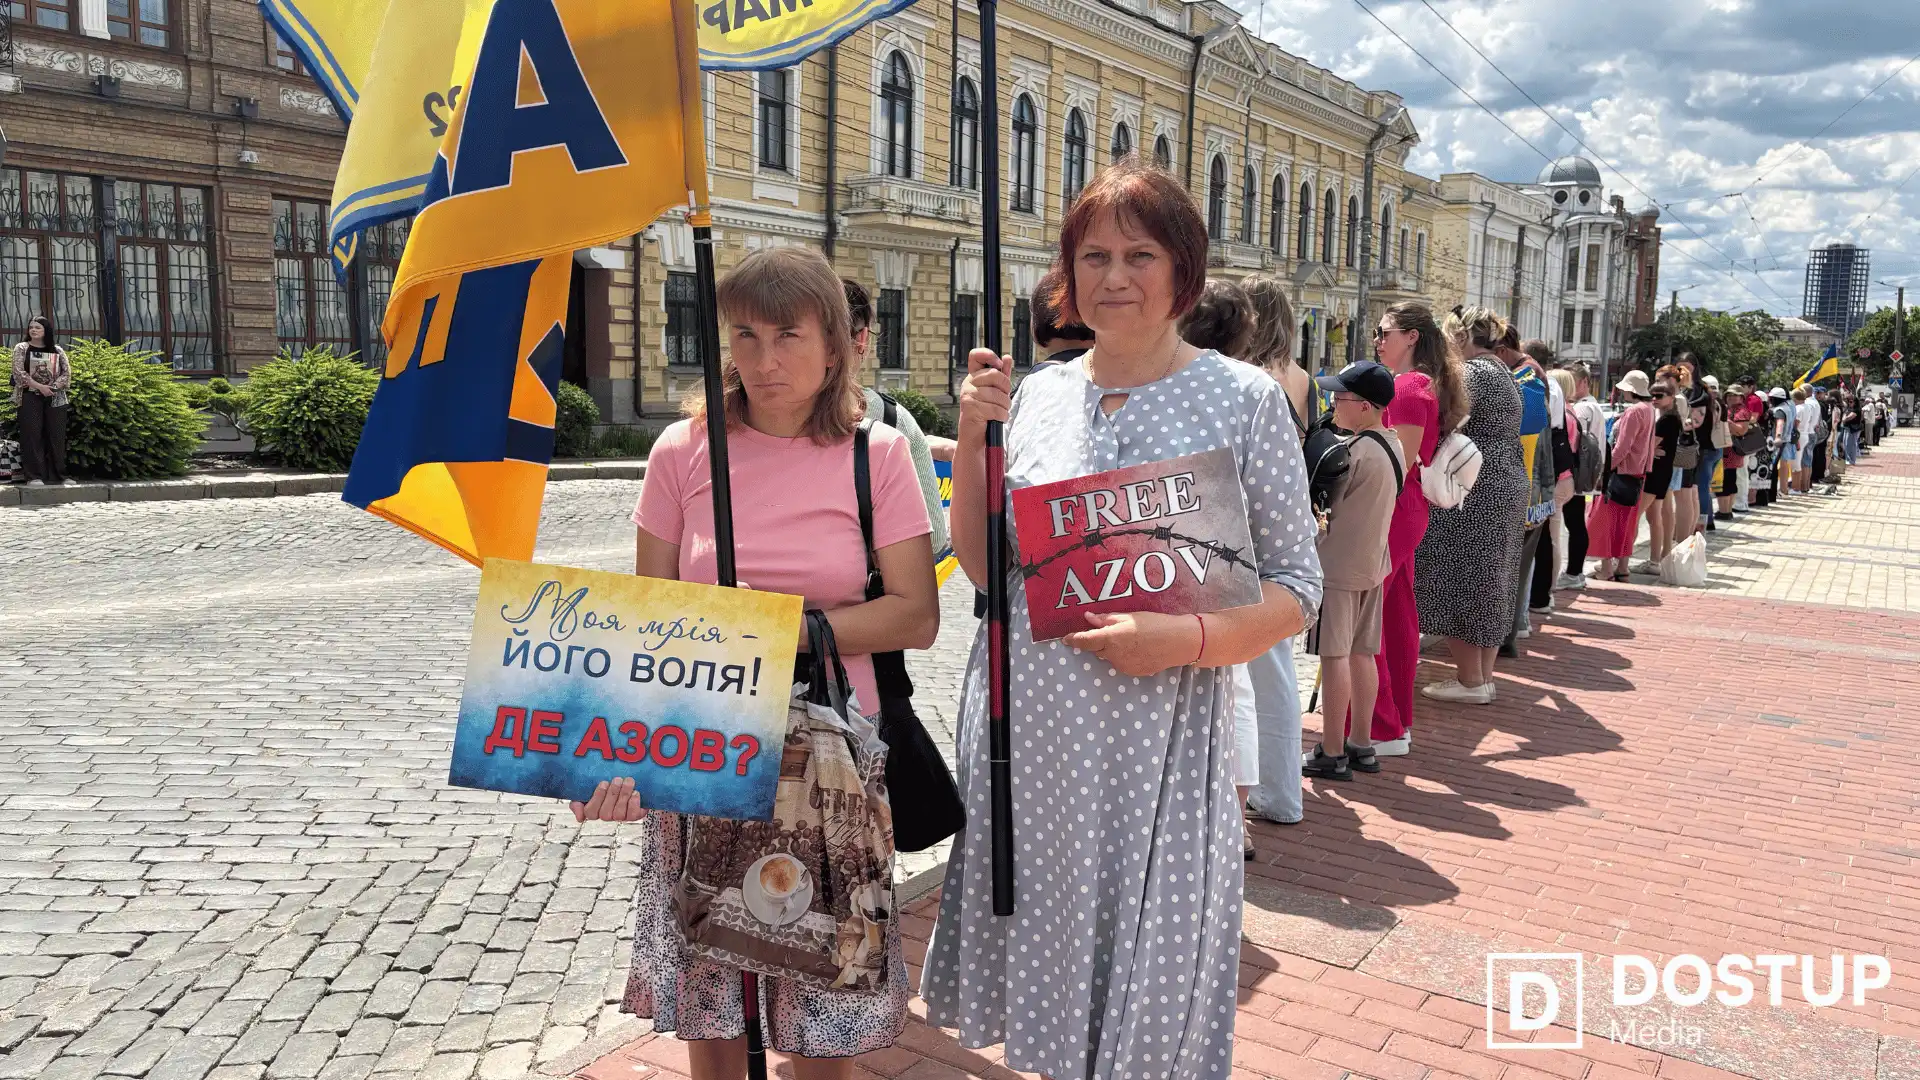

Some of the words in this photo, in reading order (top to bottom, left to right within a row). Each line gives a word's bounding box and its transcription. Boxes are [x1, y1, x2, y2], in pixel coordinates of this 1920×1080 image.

[1045, 472, 1201, 539] FREE
[1055, 541, 1218, 609] AZOV
[501, 580, 627, 642] Моя
[638, 616, 728, 651] мрія
[502, 628, 611, 678] ЙОГО
[630, 653, 762, 696] ВОЛЯ!
[484, 706, 565, 758] ДЕ
[574, 717, 760, 776] АЗОВ?
